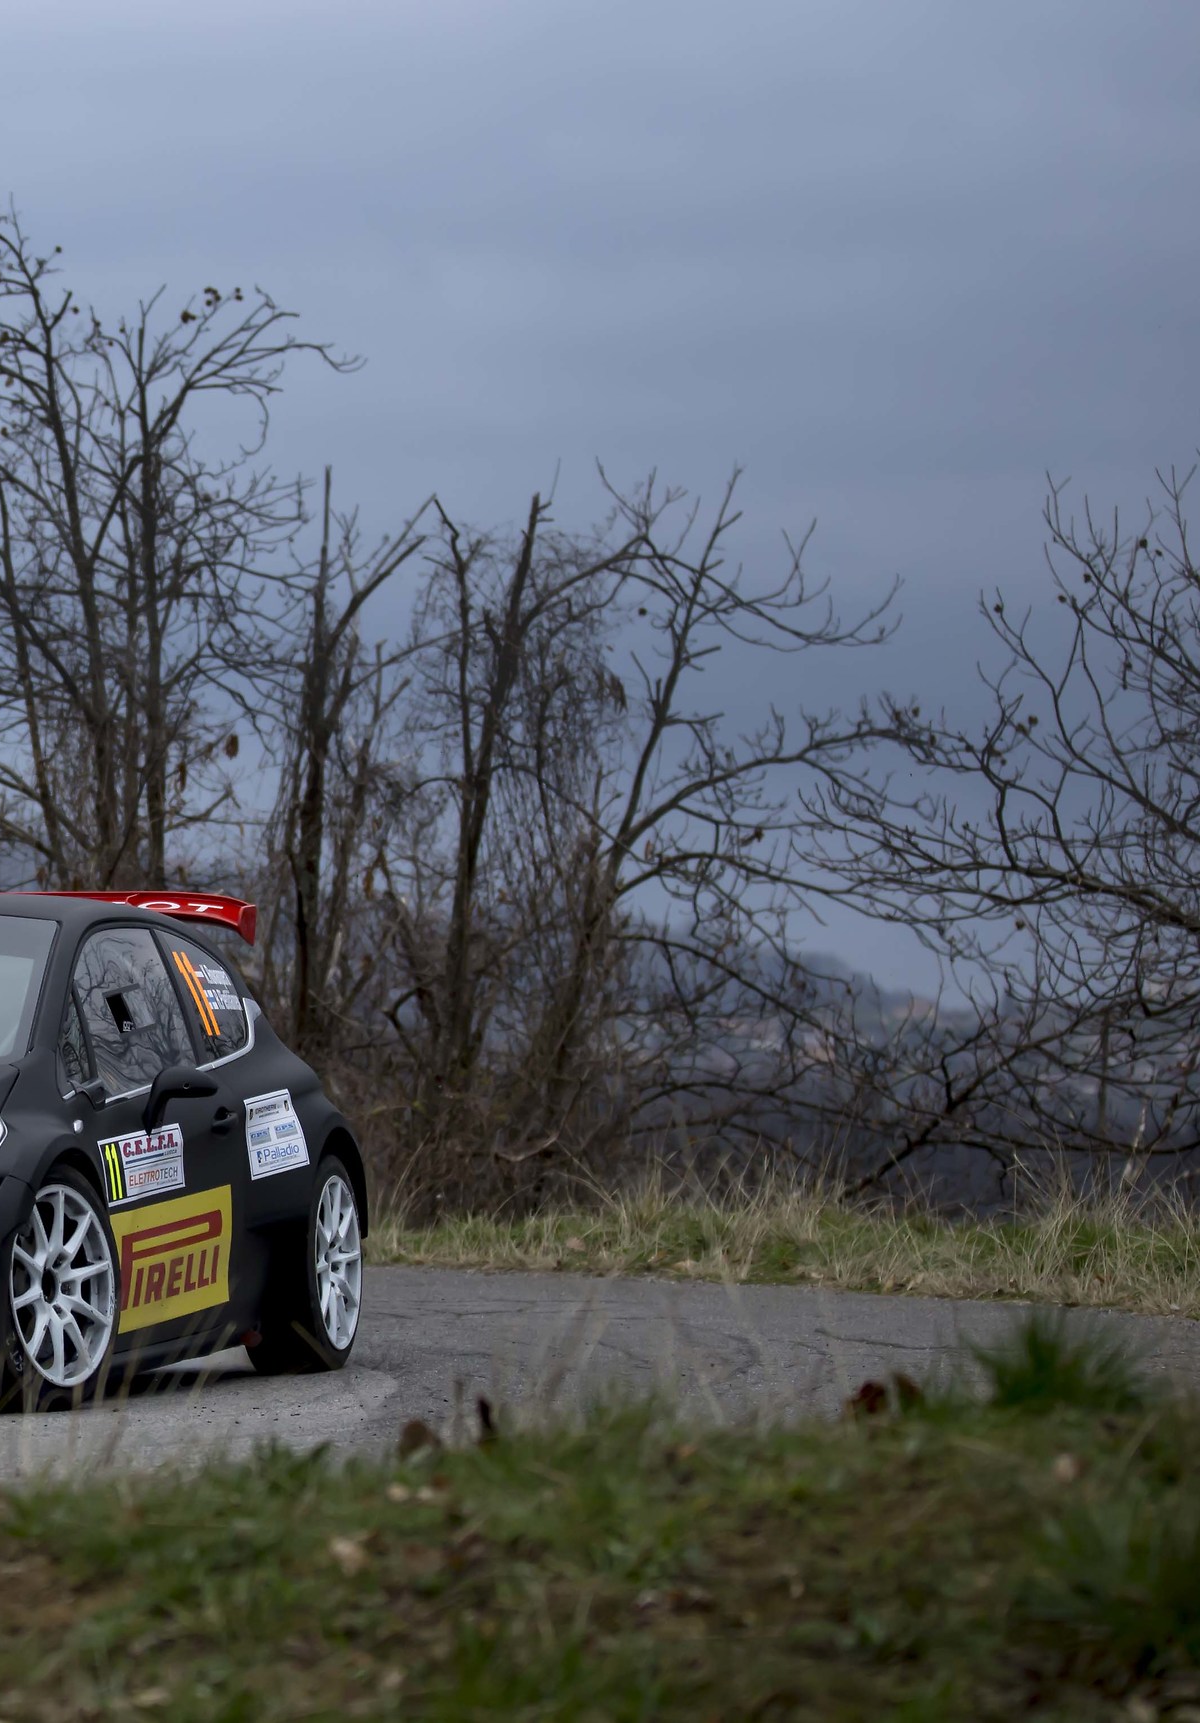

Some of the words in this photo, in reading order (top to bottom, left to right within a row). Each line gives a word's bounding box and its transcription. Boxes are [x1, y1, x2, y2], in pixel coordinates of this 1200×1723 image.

[172, 951, 220, 1036] 11
[105, 1143, 123, 1200] 11
[128, 1166, 178, 1187] ELETTROTECH
[263, 1143, 300, 1161] Palladio
[120, 1209, 222, 1312] PIRELLI
